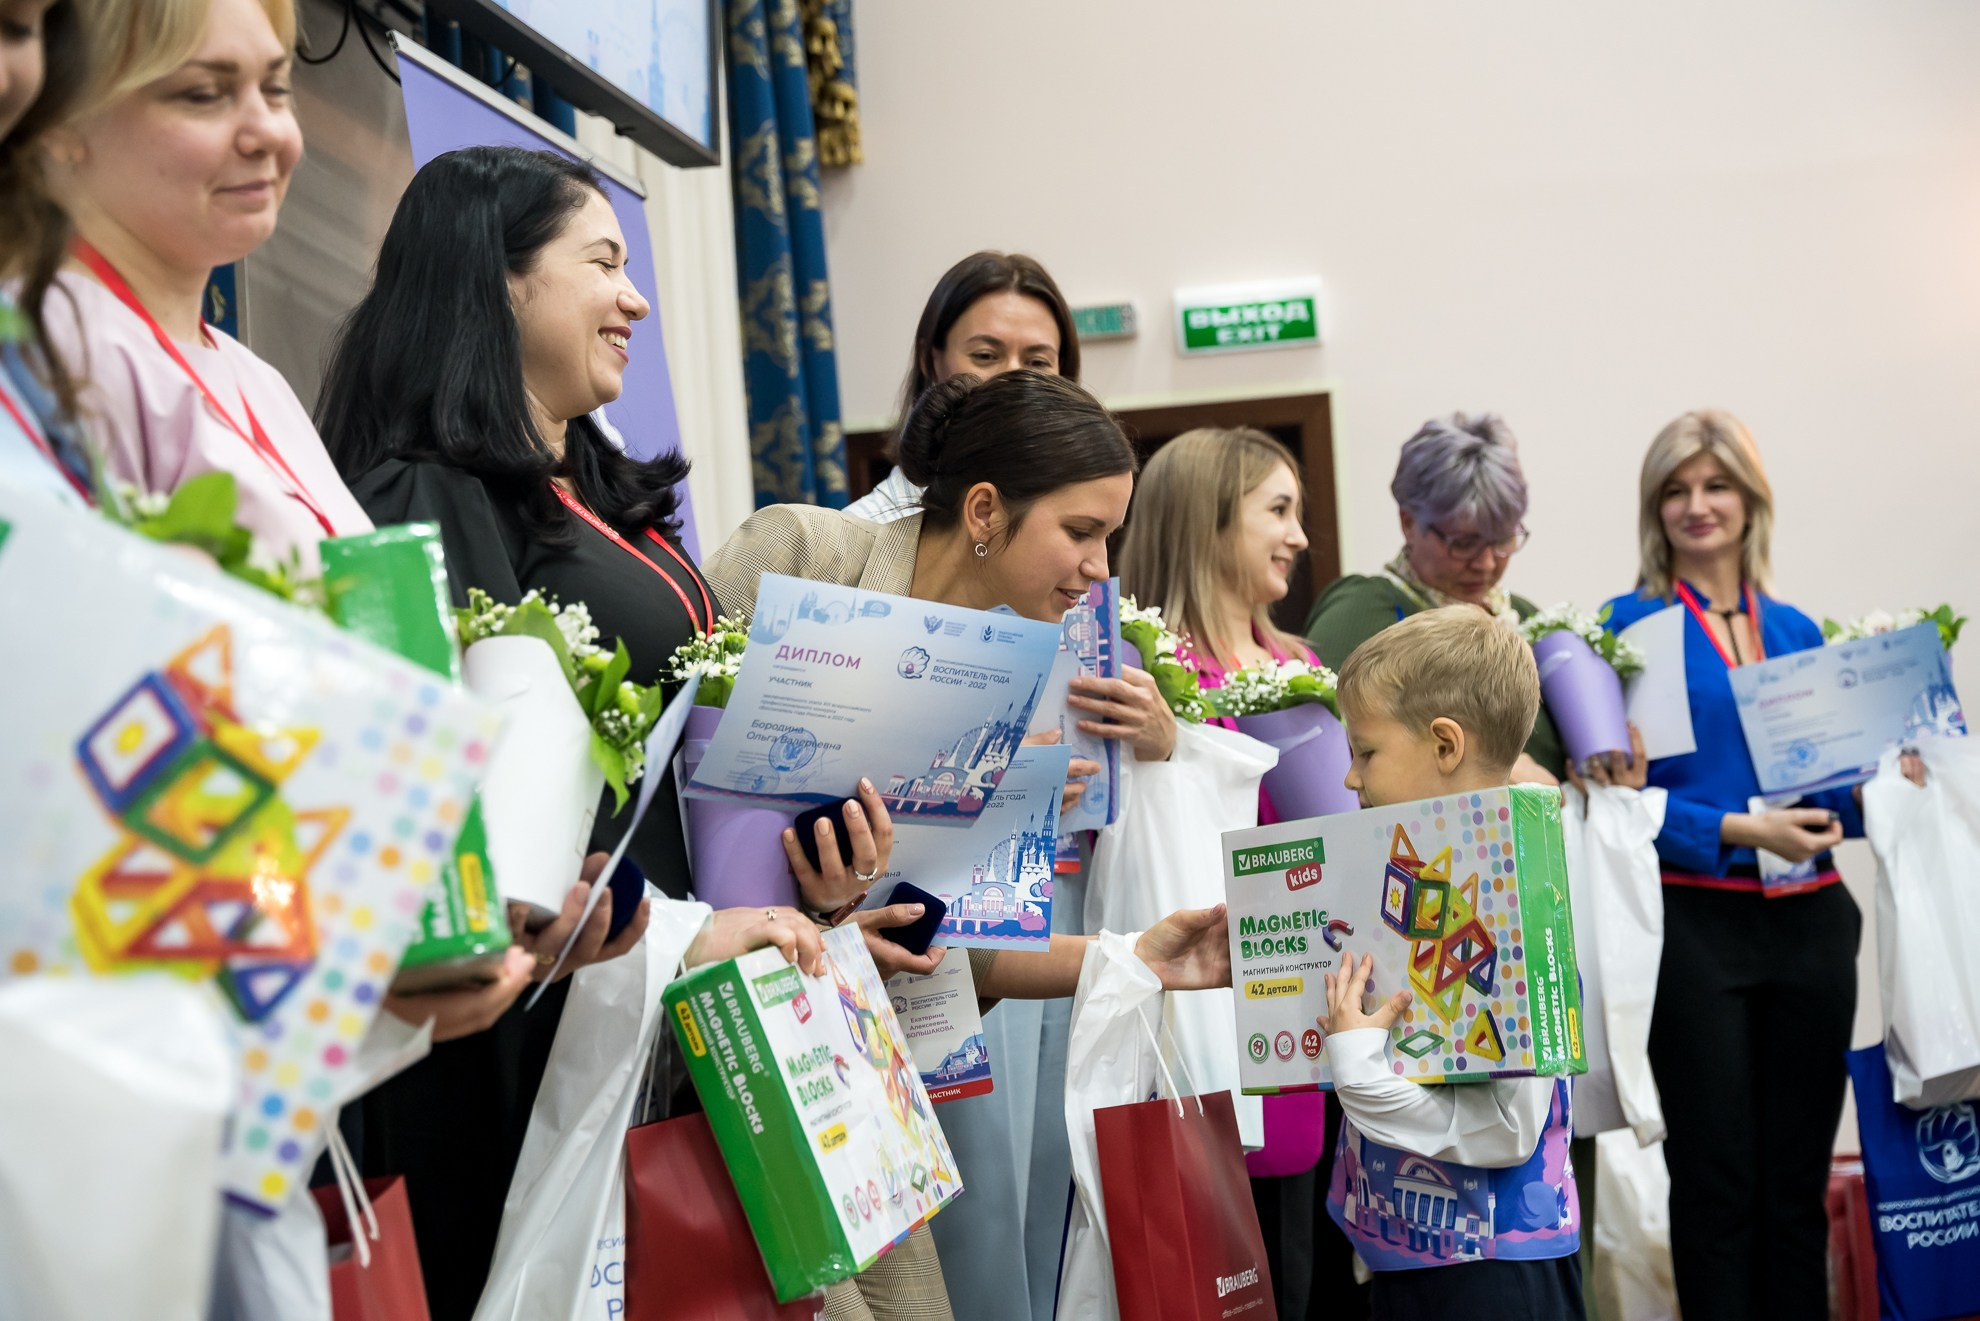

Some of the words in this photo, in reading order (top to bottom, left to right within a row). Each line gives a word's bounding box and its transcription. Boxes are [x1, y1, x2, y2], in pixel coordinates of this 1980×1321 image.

[1187, 301, 1310, 329] ВЫХОД
[1216, 324, 1284, 344] EXIT
[775, 645, 861, 669] ДИПЛОМ
[768, 676, 814, 688] УЧАСТНИК
[930, 674, 962, 686] РОССИИ
[968, 681, 987, 690] 2022
[933, 665, 988, 681] ВОСПИТАТЕЛЬ
[988, 672, 1010, 684] ГОДА
[751, 719, 805, 734] Бородина
[746, 731, 777, 743] Ольга
[780, 735, 842, 751] Валерьевна
[1251, 846, 1314, 868] BRAUBERG
[1289, 867, 1318, 887] kids
[1239, 909, 1329, 936] MAGNETIC
[1240, 935, 1307, 959] BLOCKS
[1545, 927, 1557, 982] BLOCKS
[1242, 964, 1285, 977] МАГНИТНЫЙ
[1285, 960, 1332, 972] КОНСТРУКТОР
[1251, 984, 1265, 996] 42
[1266, 985, 1298, 996] детали
[911, 996, 945, 1006] ВОСПИТАТЕЛЬ
[1536, 976, 1552, 1046] BRAUBERG
[680, 1007, 691, 1021] 42
[910, 1013, 945, 1023] Екатерина
[906, 1025, 954, 1039] БОЛЬШАКОВА
[909, 1020, 949, 1031] Алексеевна
[726, 999, 764, 1074] BRAUBERG
[1304, 1035, 1318, 1047] 42
[699, 991, 739, 1072] MAGNETIC
[732, 1073, 764, 1135] BLOCKS
[928, 1089, 961, 1100] ЧАСТНИК
[1879, 1199, 1980, 1232] ВОСПИТАТЕ
[1225, 1268, 1258, 1293] BRAUBERG
